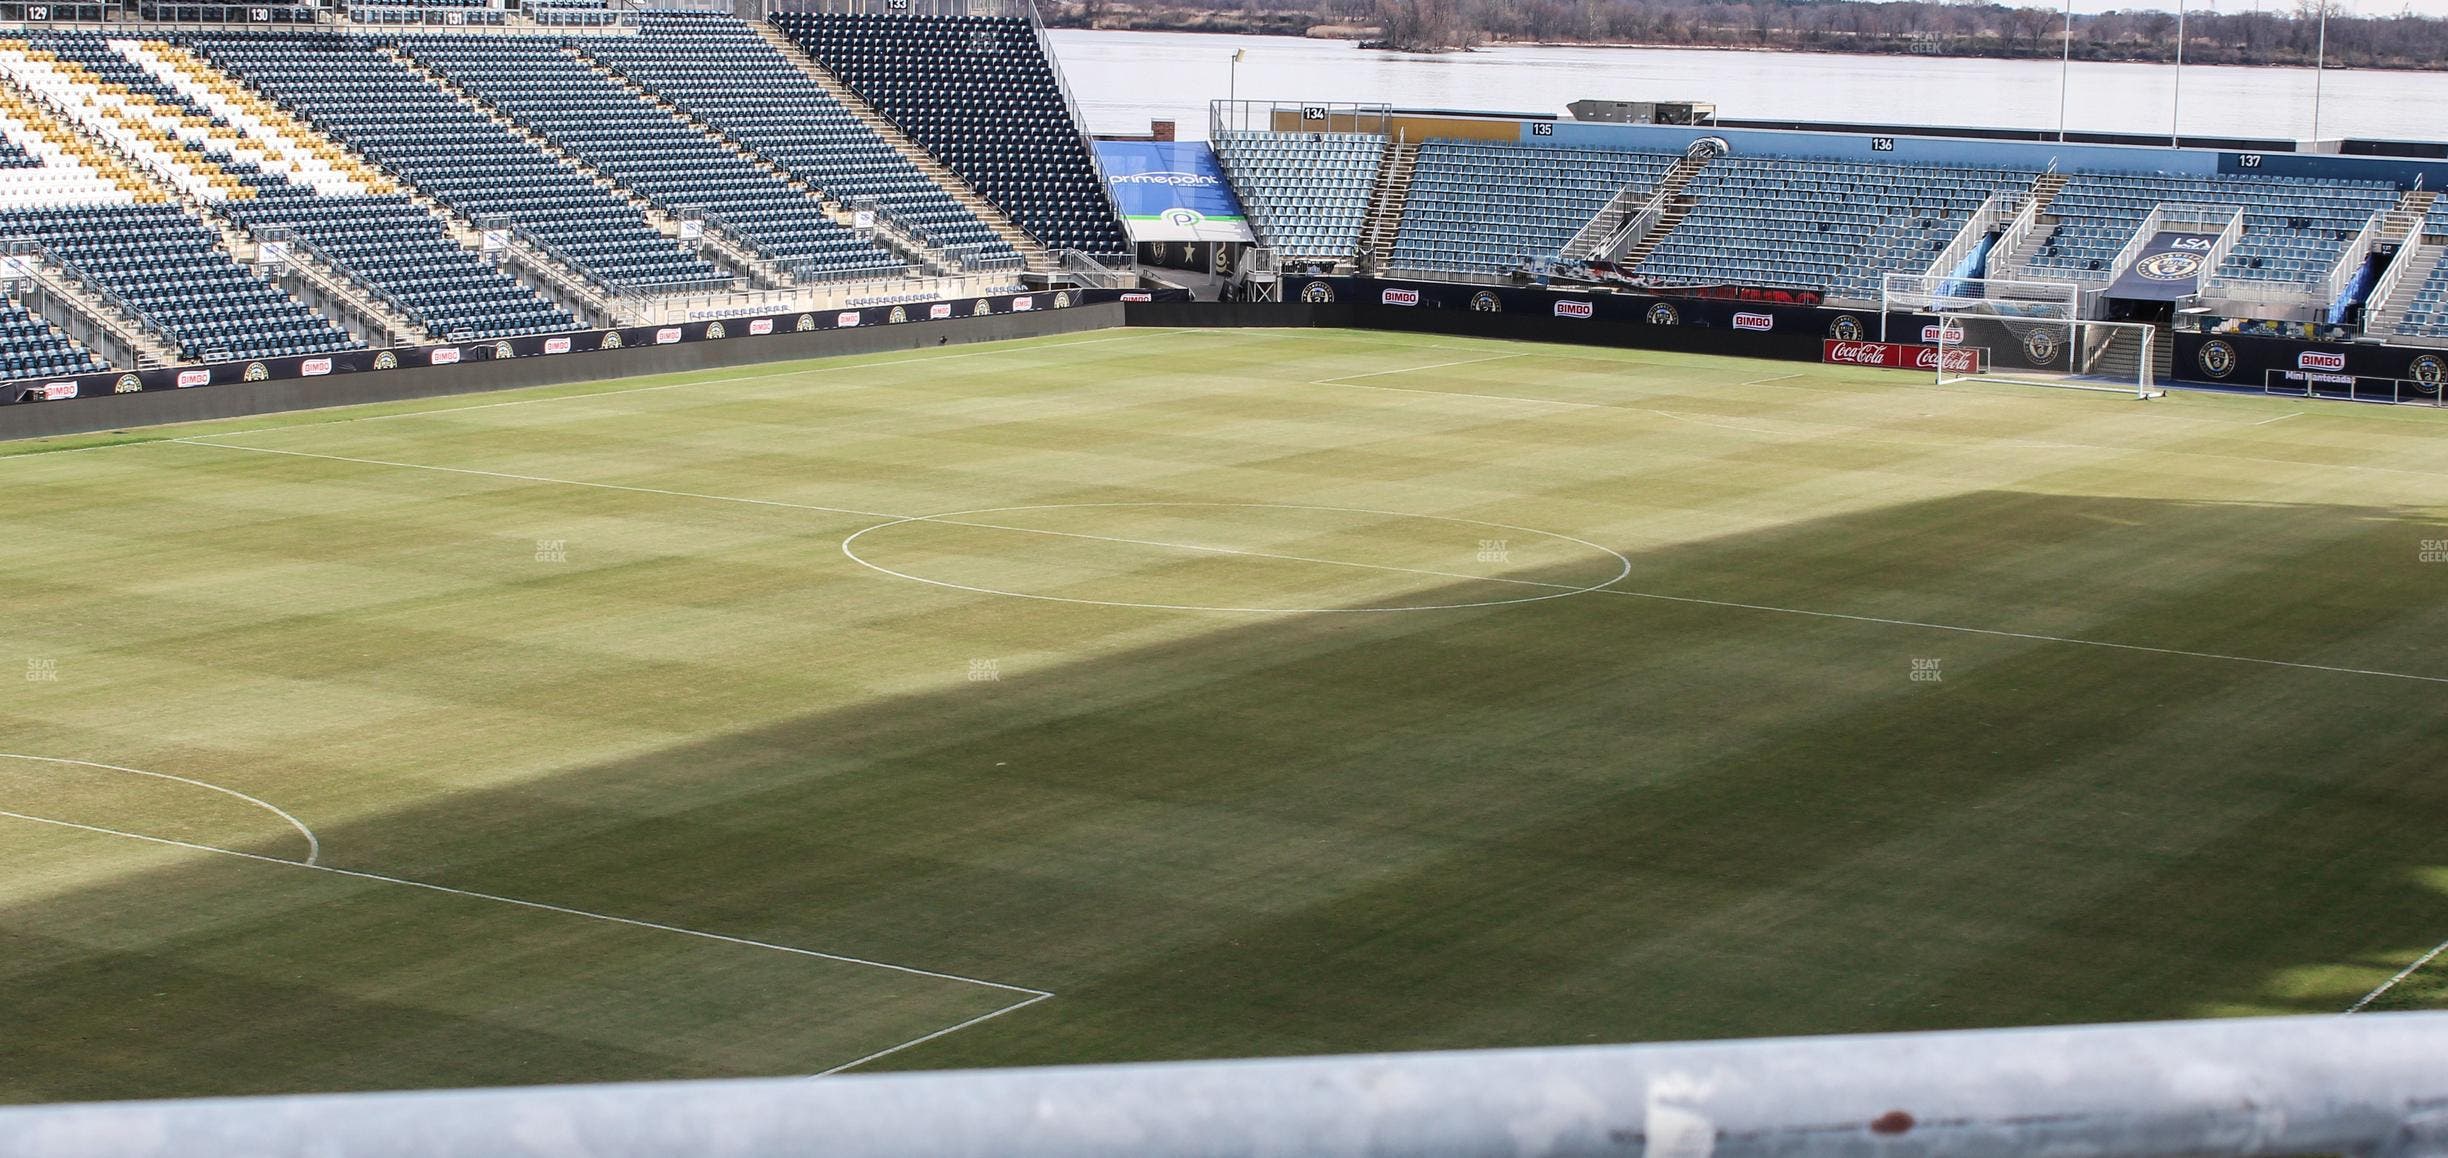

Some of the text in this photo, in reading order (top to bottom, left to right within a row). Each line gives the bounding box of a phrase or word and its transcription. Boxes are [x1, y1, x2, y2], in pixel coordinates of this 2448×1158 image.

[889, 0, 907, 9] 133
[29, 7, 47, 20] 129
[252, 9, 268, 21] 130
[448, 13, 462, 25] 131
[1305, 108, 1324, 120] 134
[1534, 124, 1552, 135] 135
[1873, 139, 1892, 150] 136
[2240, 155, 2261, 167] 137
[1109, 173, 1219, 186] primepoint
[2171, 237, 2211, 250] LSA
[1385, 293, 1416, 303] BIMBO
[1557, 303, 1590, 315] BIMBO
[1736, 316, 1770, 327] BIMBO
[434, 351, 457, 361] BIMBO
[1916, 348, 1974, 370] CocaCola
[2302, 355, 2341, 367] BIMBO
[305, 361, 329, 372] BIMBO
[181, 373, 207, 384] BIMBO
[2286, 371, 2355, 384] Mini antecada
